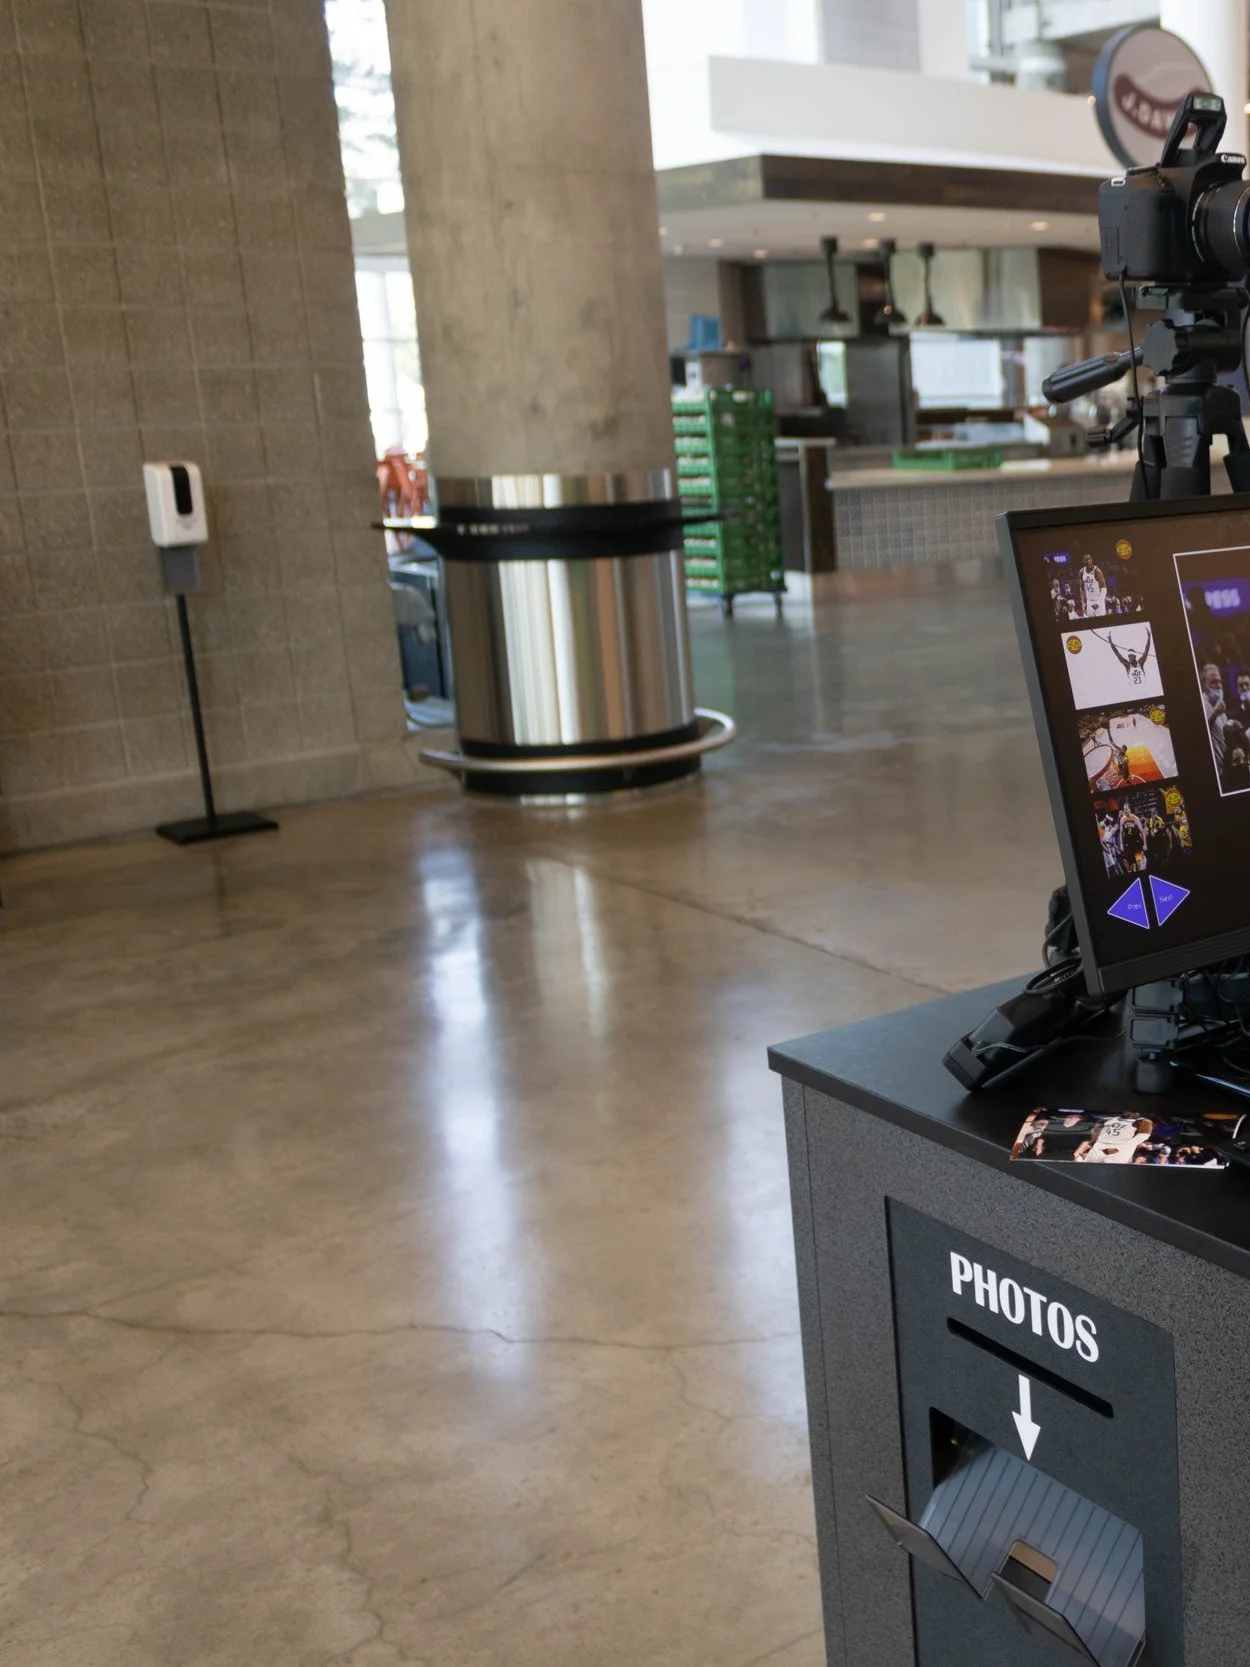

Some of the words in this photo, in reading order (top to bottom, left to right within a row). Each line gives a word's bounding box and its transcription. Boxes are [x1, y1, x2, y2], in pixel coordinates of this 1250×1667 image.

[1220, 154, 1245, 164] Canon
[1159, 894, 1173, 903] Next
[949, 1251, 1100, 1363] PHOTOS
